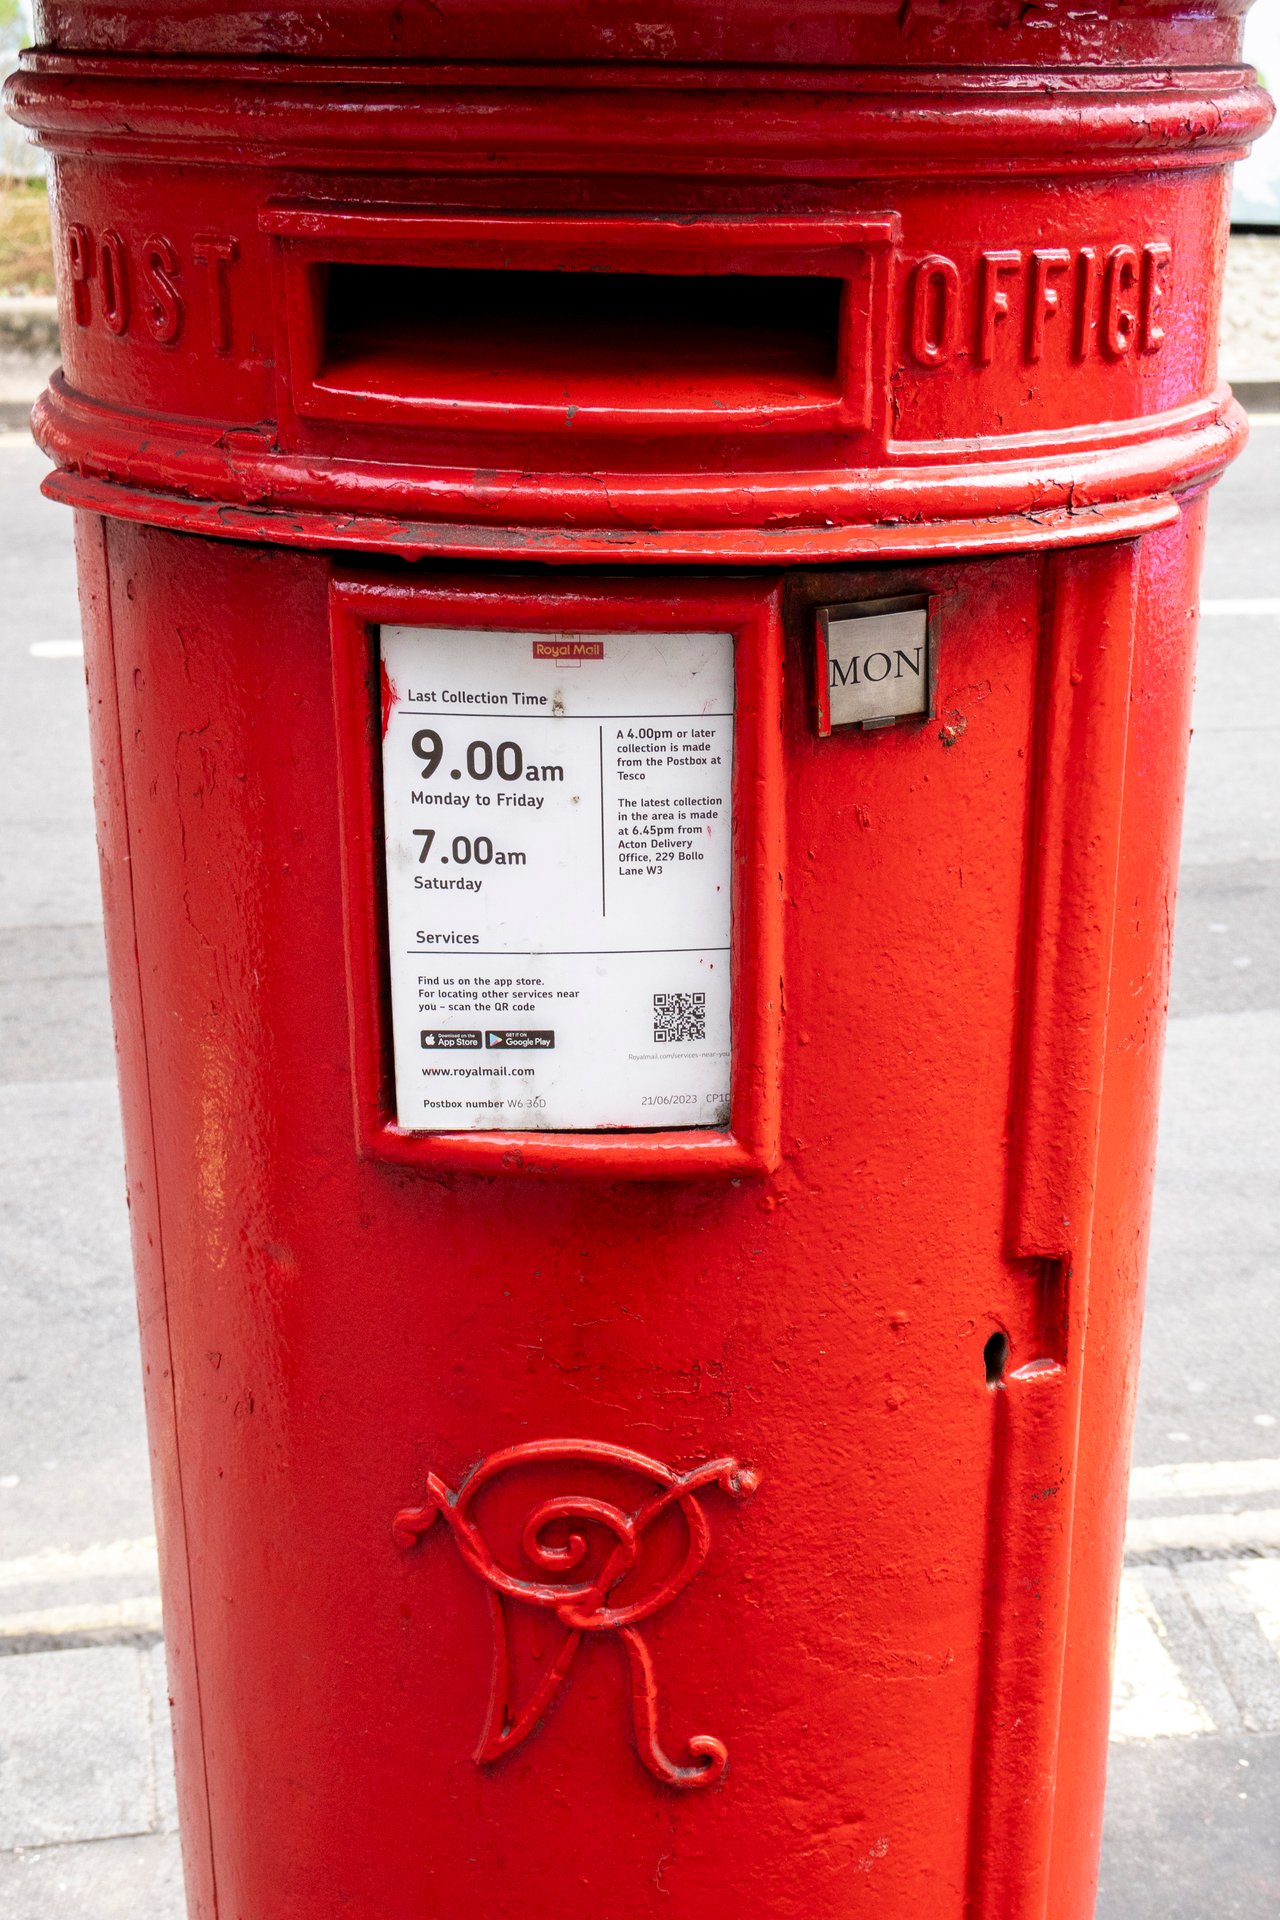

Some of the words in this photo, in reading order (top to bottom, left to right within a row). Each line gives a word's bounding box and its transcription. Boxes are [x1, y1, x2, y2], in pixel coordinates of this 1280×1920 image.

[67, 222, 239, 353] POST
[908, 243, 1171, 366] OFFICE
[537, 644, 570, 657] Royal
[574, 645, 599, 655] Mail
[830, 647, 922, 687] MON
[408, 688, 437, 703] Last
[441, 690, 508, 705] Collection
[511, 692, 548, 706] Time
[616, 729, 624, 740] A
[626, 727, 673, 741] 4.00pm
[676, 730, 688, 739] or
[691, 728, 717, 738] later
[616, 742, 667, 753] collection
[670, 742, 679, 752] is
[682, 742, 711, 752] made
[411, 728, 564, 782] 9.00am
[616, 757, 643, 767] from
[645, 757, 663, 767] the
[666, 756, 708, 766] Postbox
[710, 755, 722, 765] at
[617, 771, 646, 781] Tesco
[411, 790, 471, 809] Monday
[475, 793, 491, 806] to
[497, 792, 545, 810] Friday
[617, 798, 637, 808] The
[640, 798, 671, 808] latest
[673, 796, 723, 807] collection
[618, 811, 628, 821] in
[631, 811, 648, 821] the
[651, 812, 675, 821] area
[678, 810, 687, 820] is
[690, 809, 719, 820] made
[617, 827, 629, 836] at
[632, 825, 674, 837] 6.45pm
[677, 824, 703, 834] from
[412, 828, 527, 865] 7.00am
[618, 839, 647, 849] Acton
[651, 838, 693, 850] Delivery
[618, 852, 652, 863] Office,
[655, 851, 675, 862] 229
[678, 851, 704, 861] Bollo
[618, 866, 644, 876] Lane
[646, 865, 663, 875] W3
[414, 875, 483, 893] Saturday
[416, 930, 480, 945] Services
[418, 976, 440, 985] Find
[443, 978, 455, 986] us
[458, 978, 471, 986] on
[473, 976, 491, 986] the
[493, 978, 513, 988] app
[515, 977, 545, 986] store.
[418, 988, 435, 998] For
[438, 989, 478, 1000] locating
[481, 989, 509, 999] other
[512, 989, 553, 999] services
[418, 1003, 437, 1013] you
[474, 1002, 491, 1011] the
[494, 1002, 509, 1012] QR
[512, 1002, 536, 1012] code
[438, 1039, 455, 1047] App
[506, 1038, 533, 1047] Google
[535, 1038, 551, 1046] Play
[421, 1066, 535, 1079] www.royalmail.com
[423, 1099, 463, 1108] Postbox
[465, 1099, 505, 1109] number
[507, 1100, 523, 1108] W6
[642, 1095, 697, 1106] 21/06/2023
